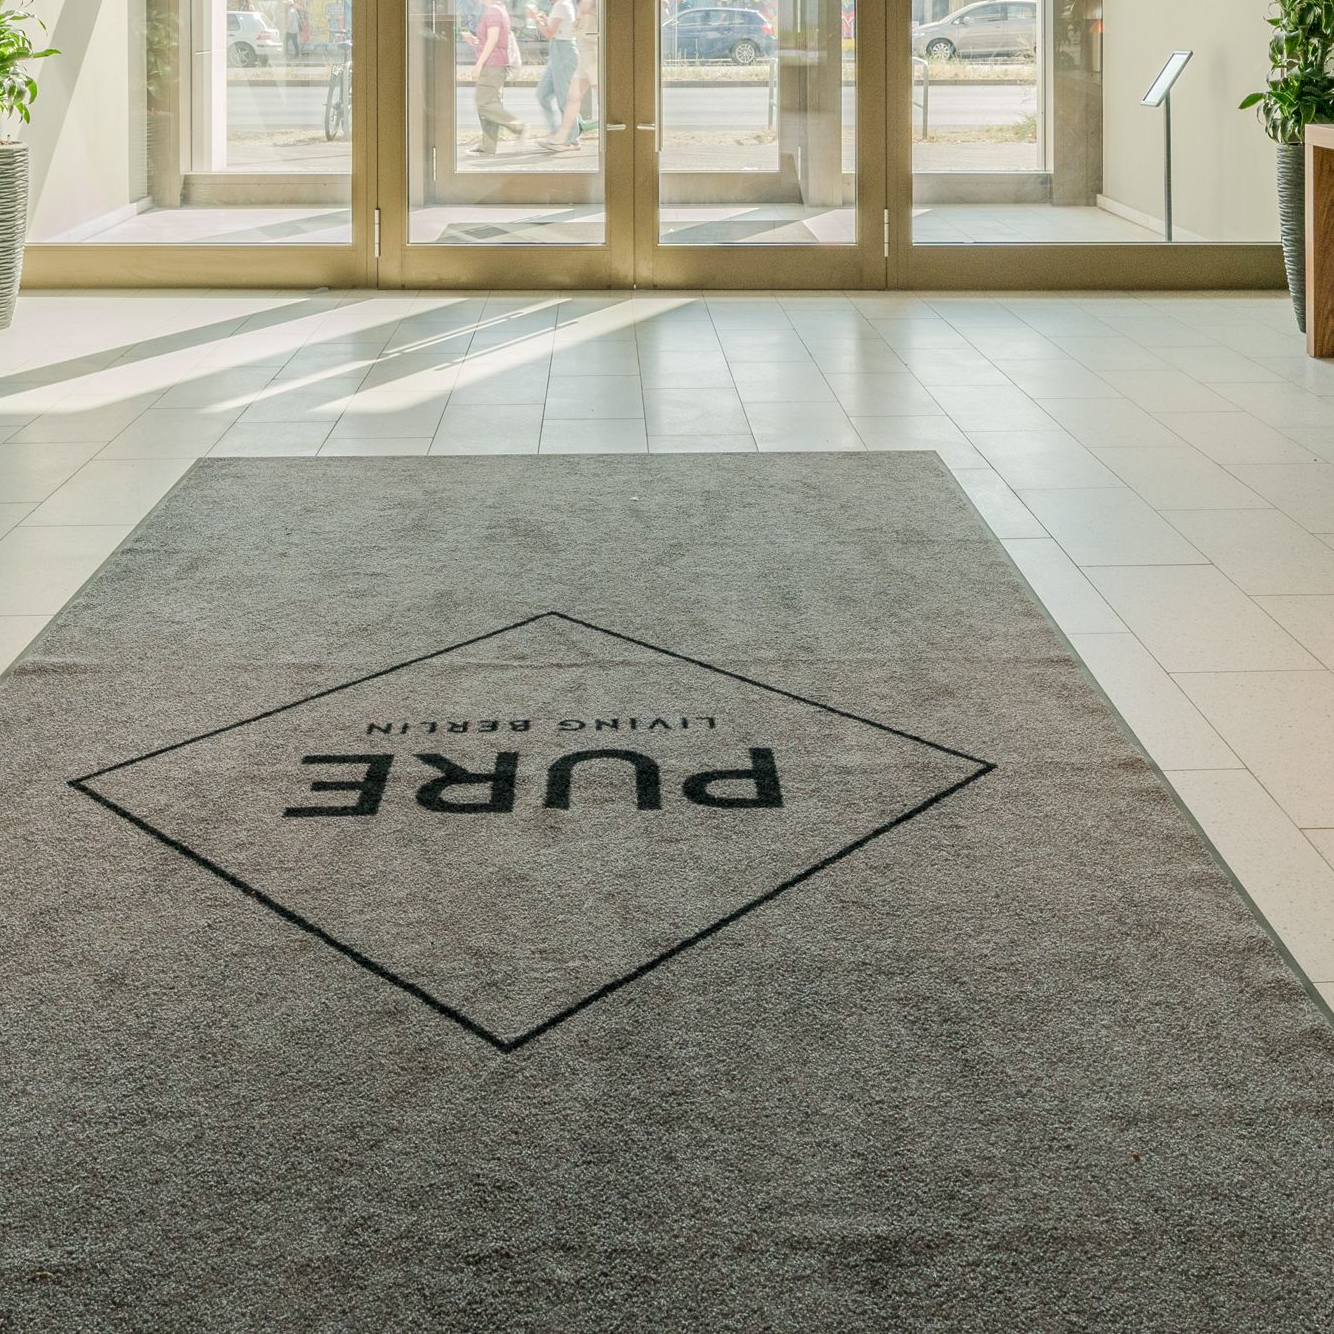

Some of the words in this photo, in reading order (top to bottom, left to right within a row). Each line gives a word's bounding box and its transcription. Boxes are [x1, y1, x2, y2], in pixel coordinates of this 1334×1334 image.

[366, 719, 531, 736] BERLIN
[558, 716, 717, 732] LIVING
[283, 746, 785, 818] PURE
